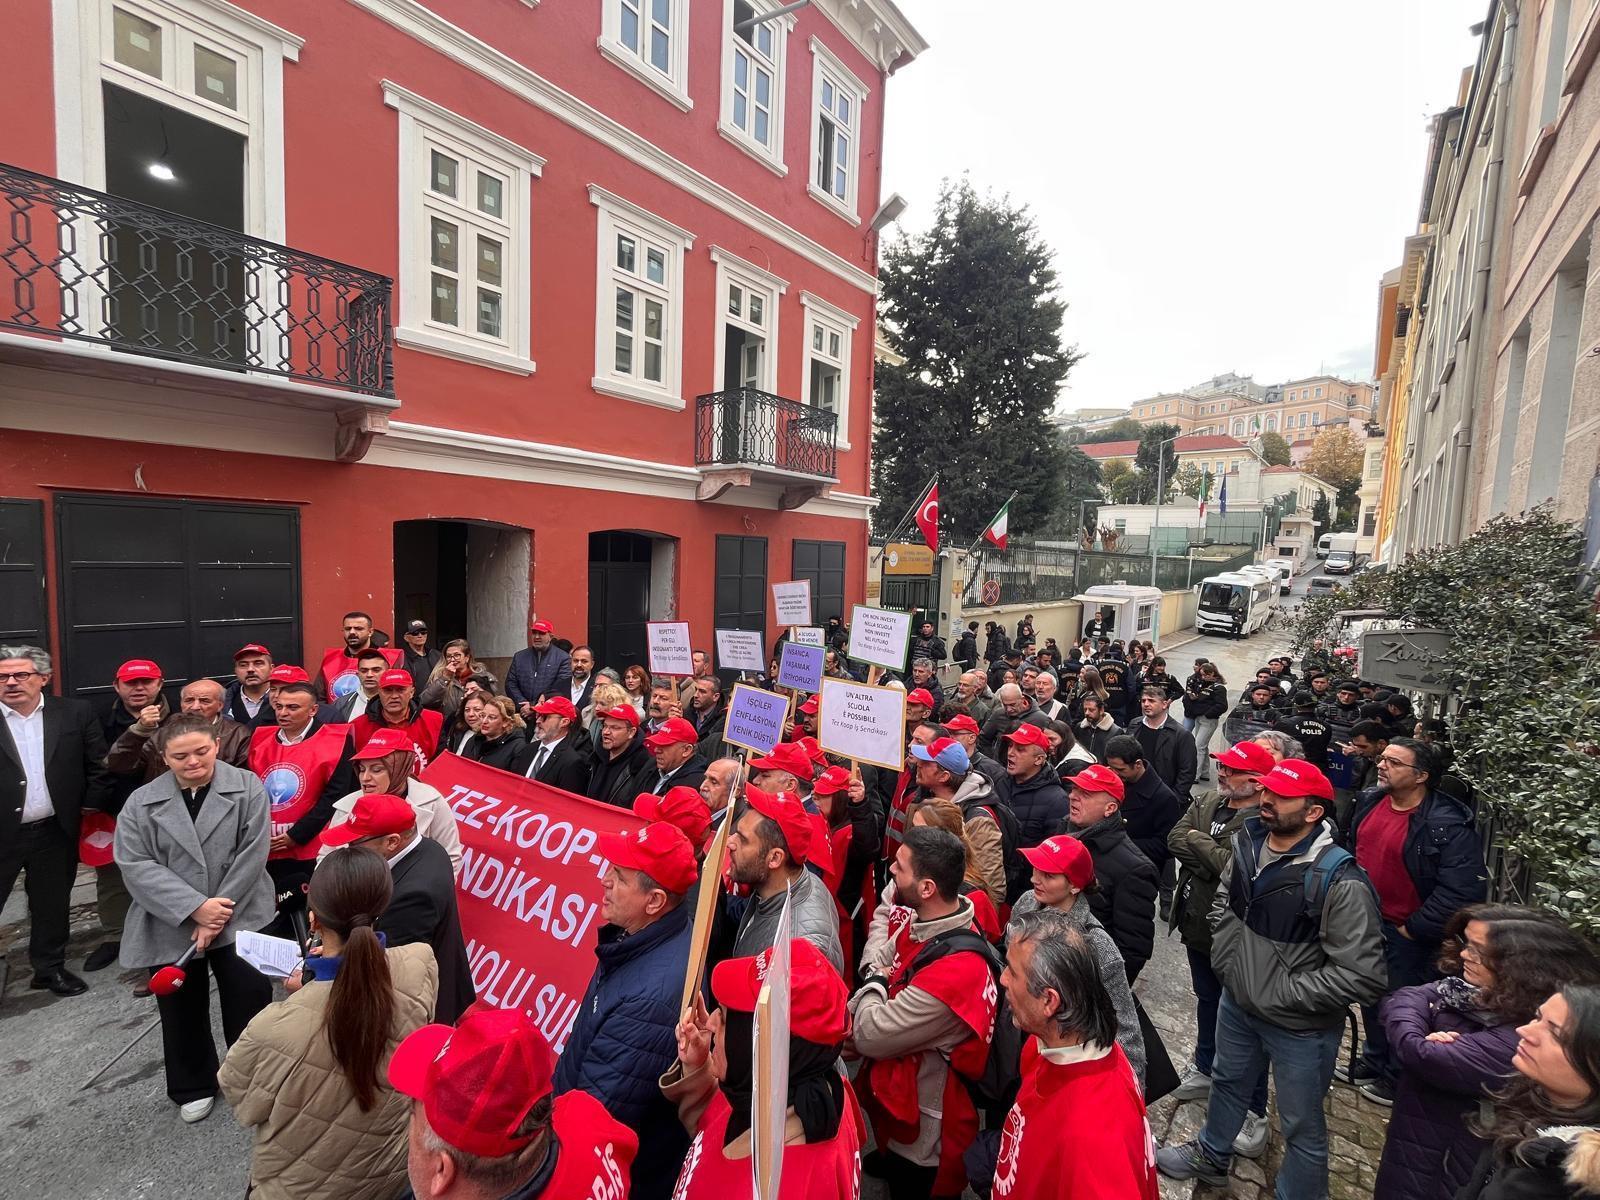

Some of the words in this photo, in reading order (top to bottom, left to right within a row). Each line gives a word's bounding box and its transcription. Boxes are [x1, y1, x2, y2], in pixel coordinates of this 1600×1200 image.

[876, 623, 893, 631] SCUOLA
[874, 630, 891, 638] INVESTE
[871, 637, 889, 646] FUTURO
[845, 691, 874, 702] UN'ALTRA
[747, 696, 773, 711] İŞÇİLER
[847, 702, 870, 712] SCUOLA
[735, 709, 777, 729] ENFLASYONA
[847, 712, 876, 724] POSSIBILE
[733, 724, 753, 738] YENİK
[840, 720, 854, 730] Koop
[860, 725, 889, 737] Sendikası
